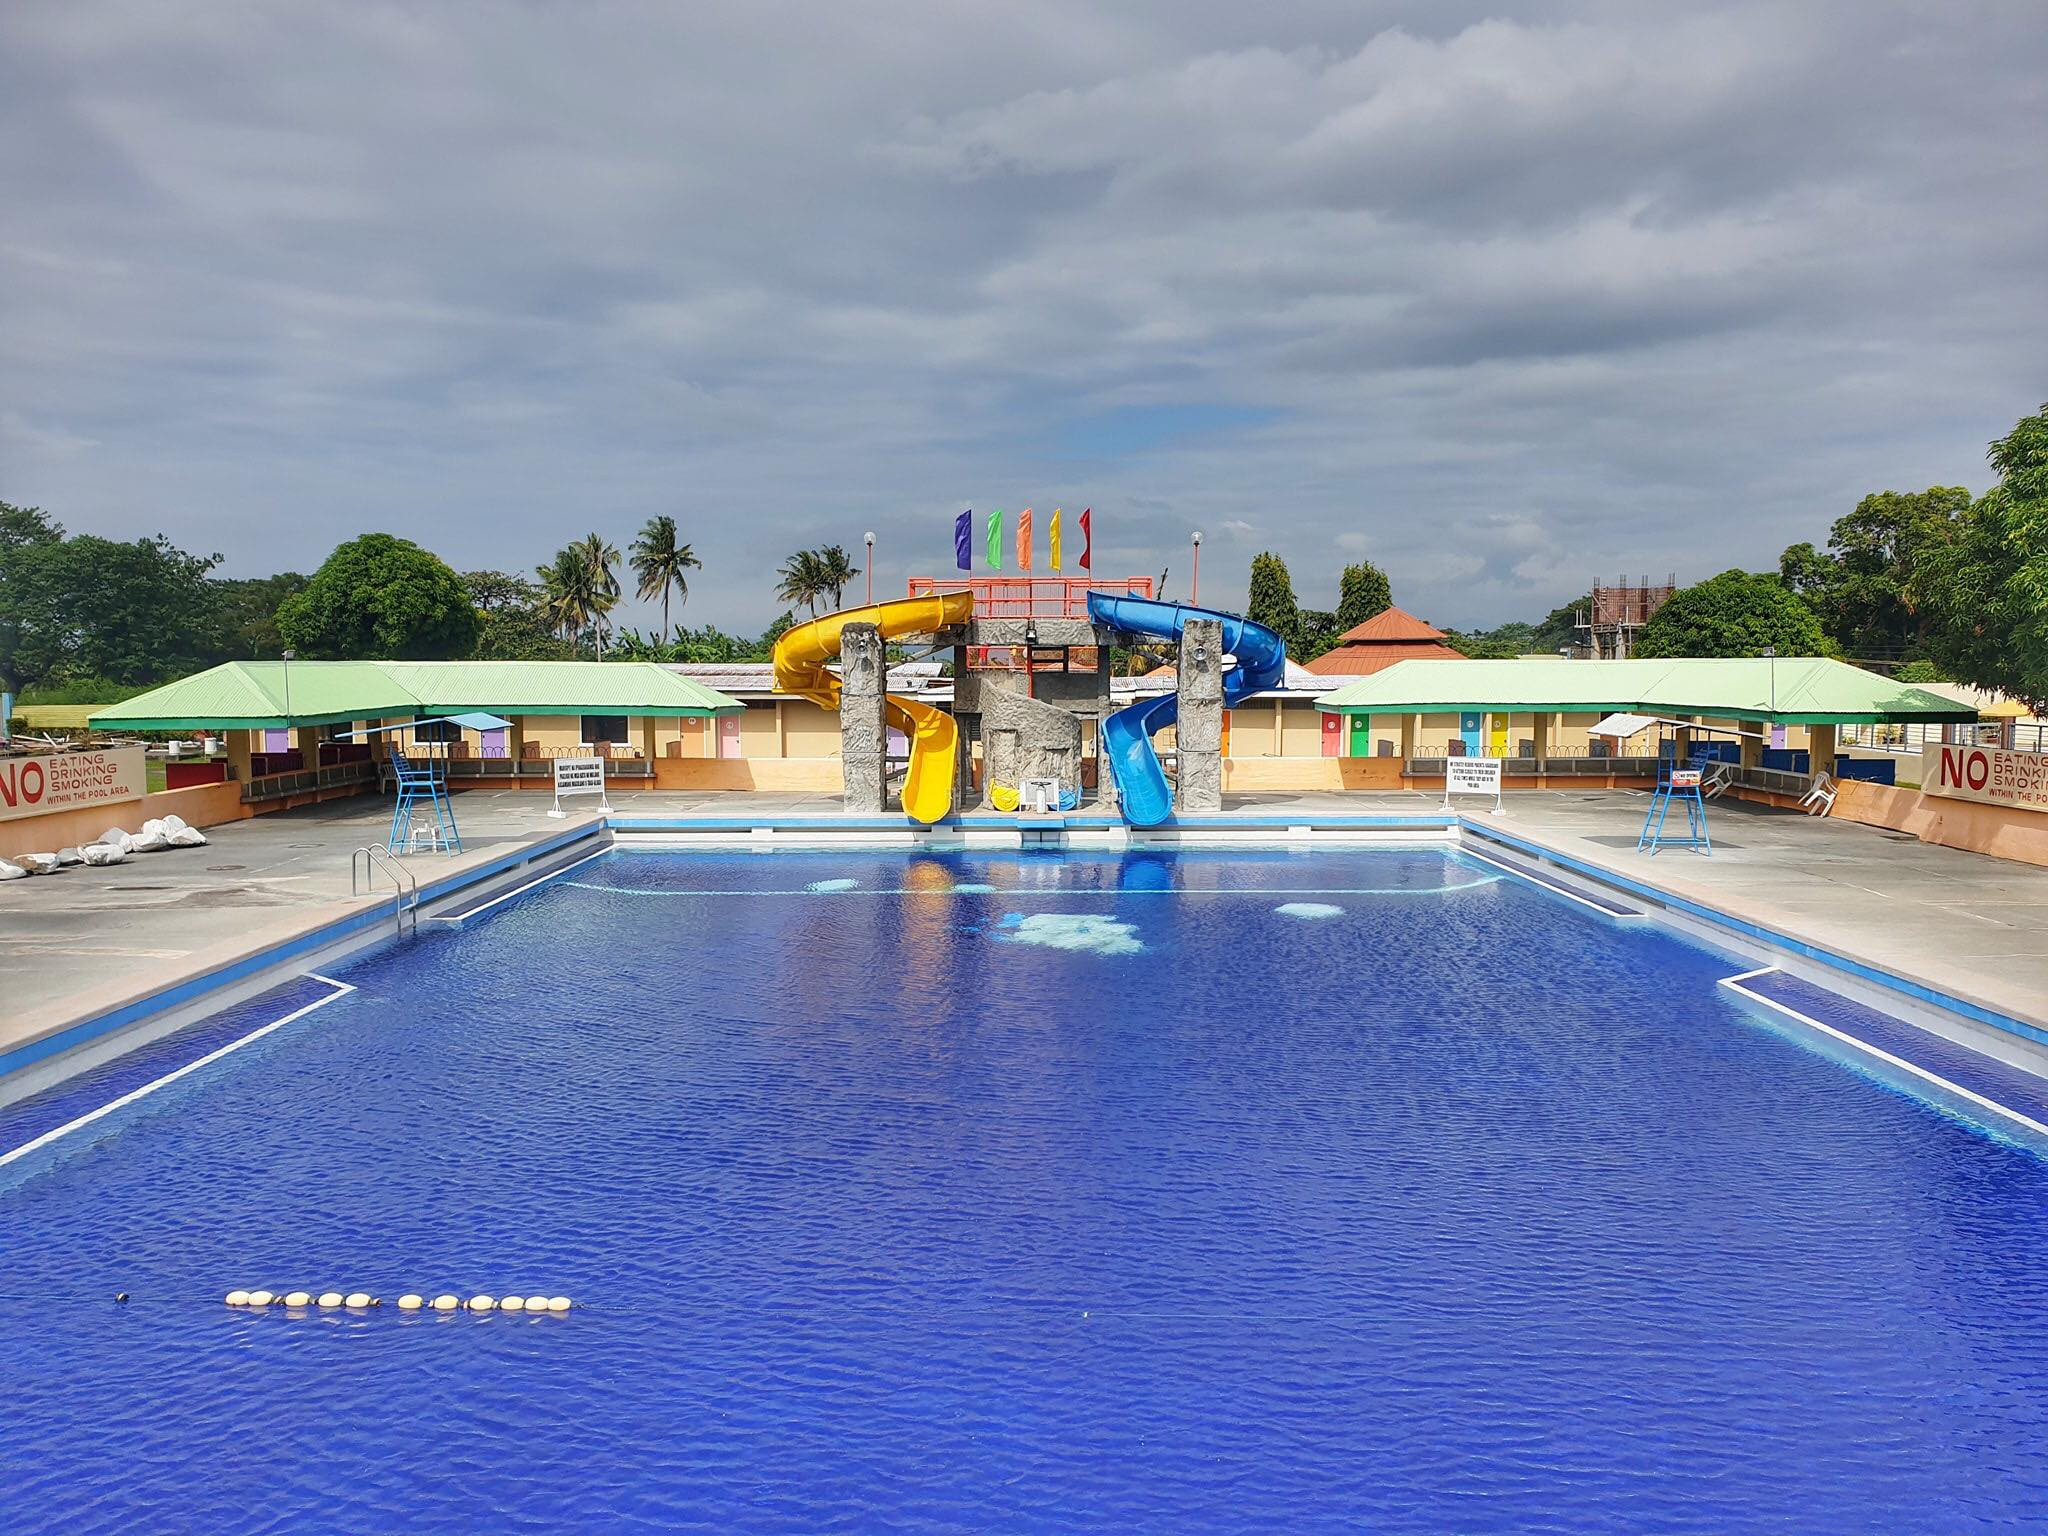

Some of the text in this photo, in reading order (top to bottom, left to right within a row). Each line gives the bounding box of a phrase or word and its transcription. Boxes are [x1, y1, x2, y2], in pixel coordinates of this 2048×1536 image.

[50, 754, 104, 769] EATING
[1994, 752, 2048, 767] EATING
[50, 763, 117, 781] DRINKING
[1940, 747, 1989, 791] NO
[1994, 764, 2048, 778] DRINKI
[0, 761, 44, 807] NO
[51, 775, 113, 792] SMOKING
[1994, 775, 2048, 790] SMOKI
[47, 786, 130, 805] WITHIN THE POOL AREA
[1988, 788, 2013, 799] WITHIN
[2017, 791, 2032, 801] THE
